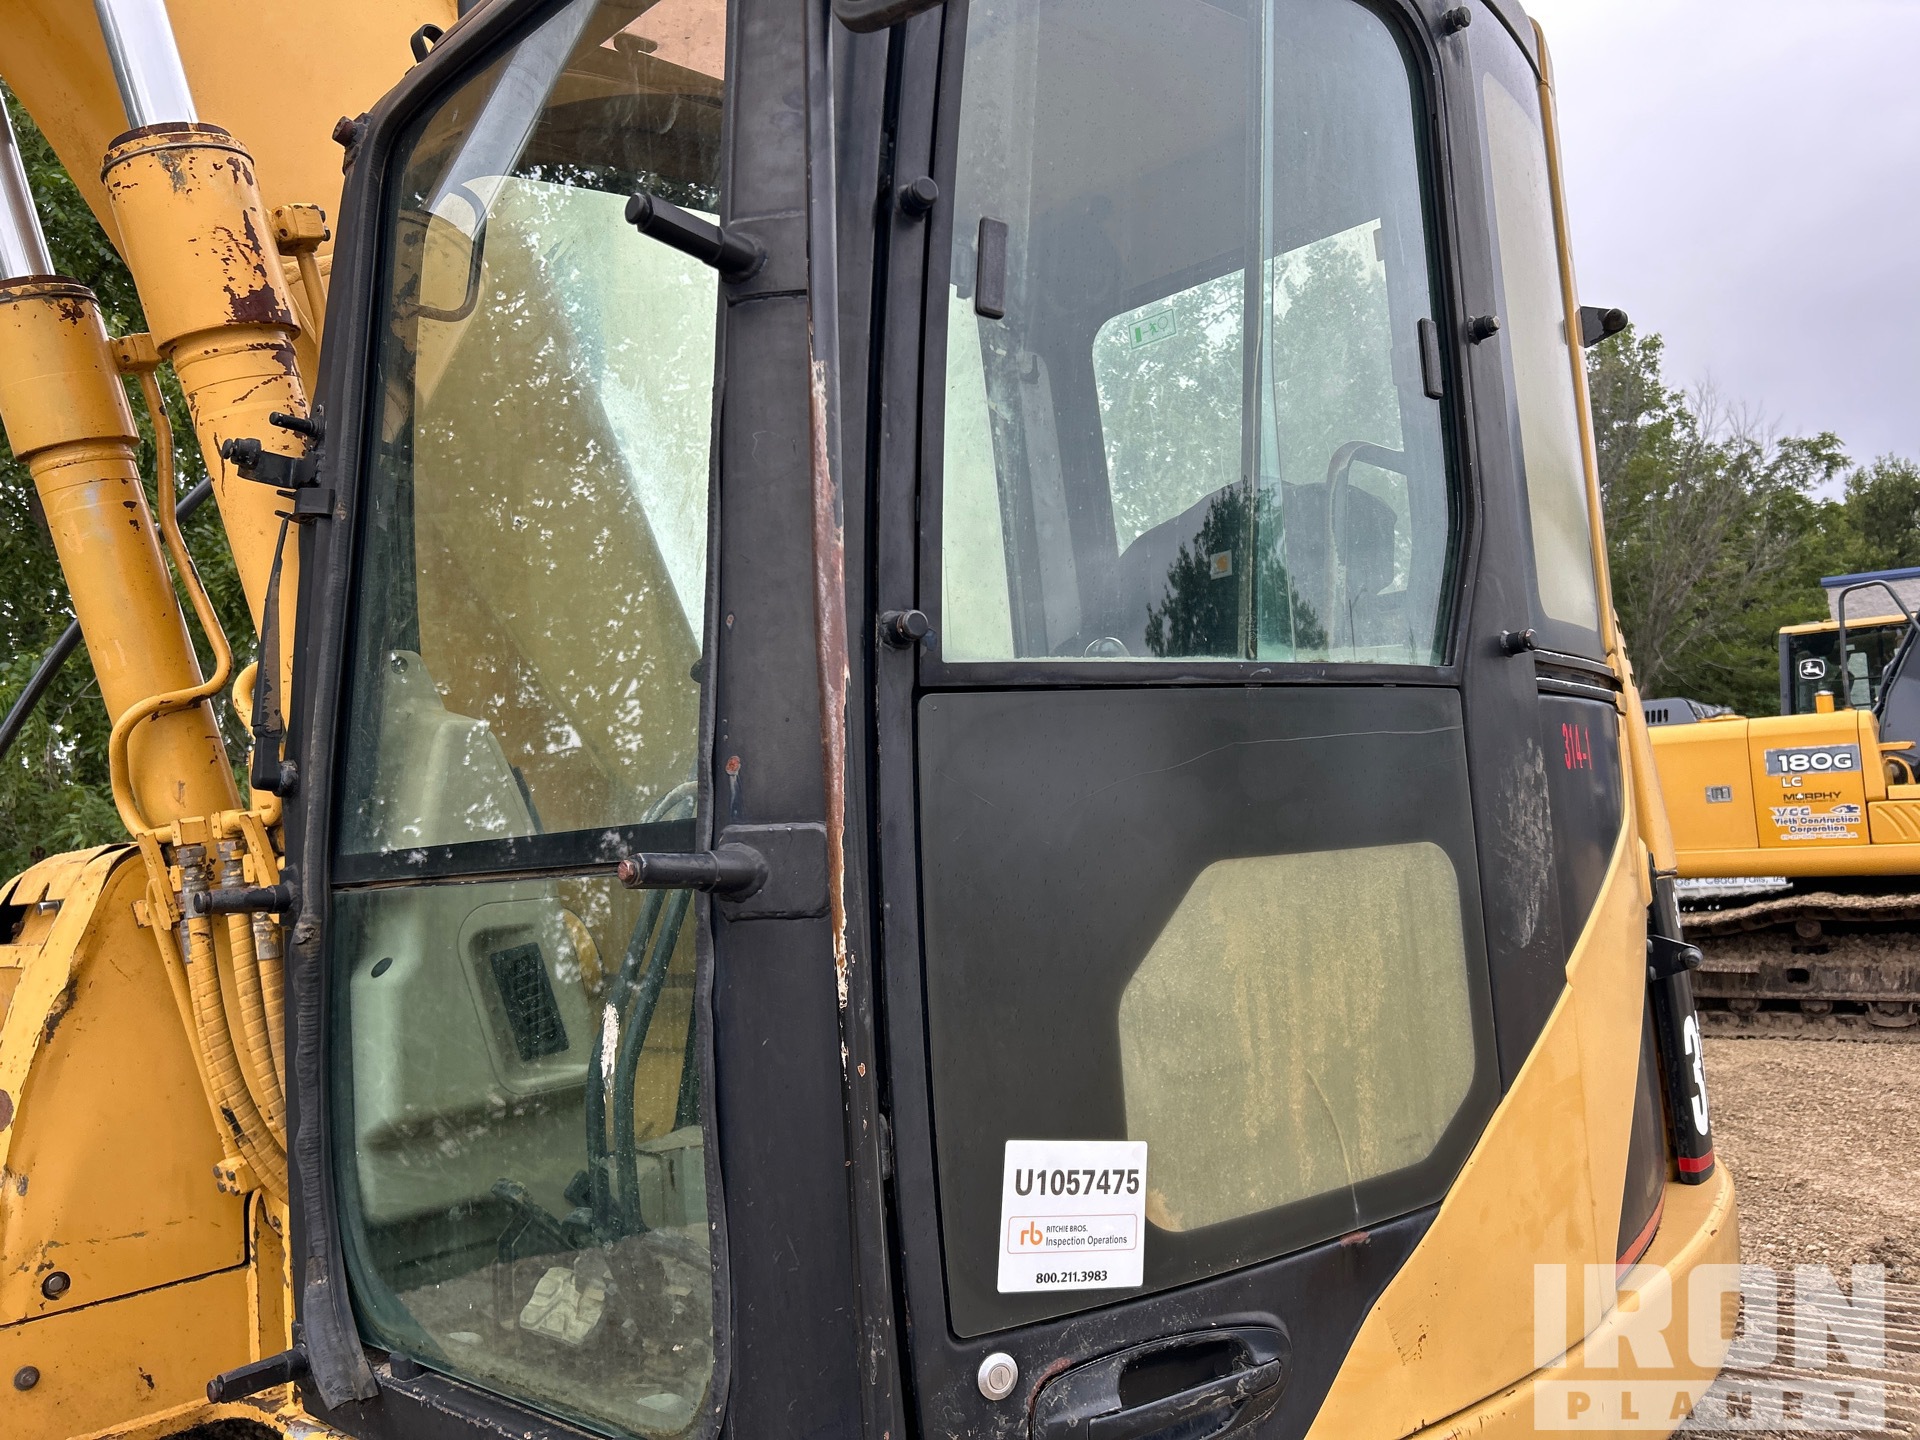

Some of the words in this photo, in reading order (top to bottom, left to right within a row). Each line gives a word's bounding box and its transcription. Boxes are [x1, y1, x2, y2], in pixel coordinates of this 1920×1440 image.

[1778, 752, 1853, 772] 180G
[1782, 776, 1803, 788] LC
[1800, 815, 1859, 825] Construction
[1789, 824, 1845, 834] Corporation
[1683, 1010, 1709, 1136] 3
[1015, 1168, 1140, 1196] U1057475
[1020, 1221, 1043, 1246] rb
[1046, 1225, 1069, 1233] RITCHIE
[1069, 1224, 1089, 1233] BROS.
[1045, 1236, 1086, 1249] Inspection
[1087, 1234, 1128, 1246] Operations
[1035, 1270, 1109, 1284] 800.211.3983
